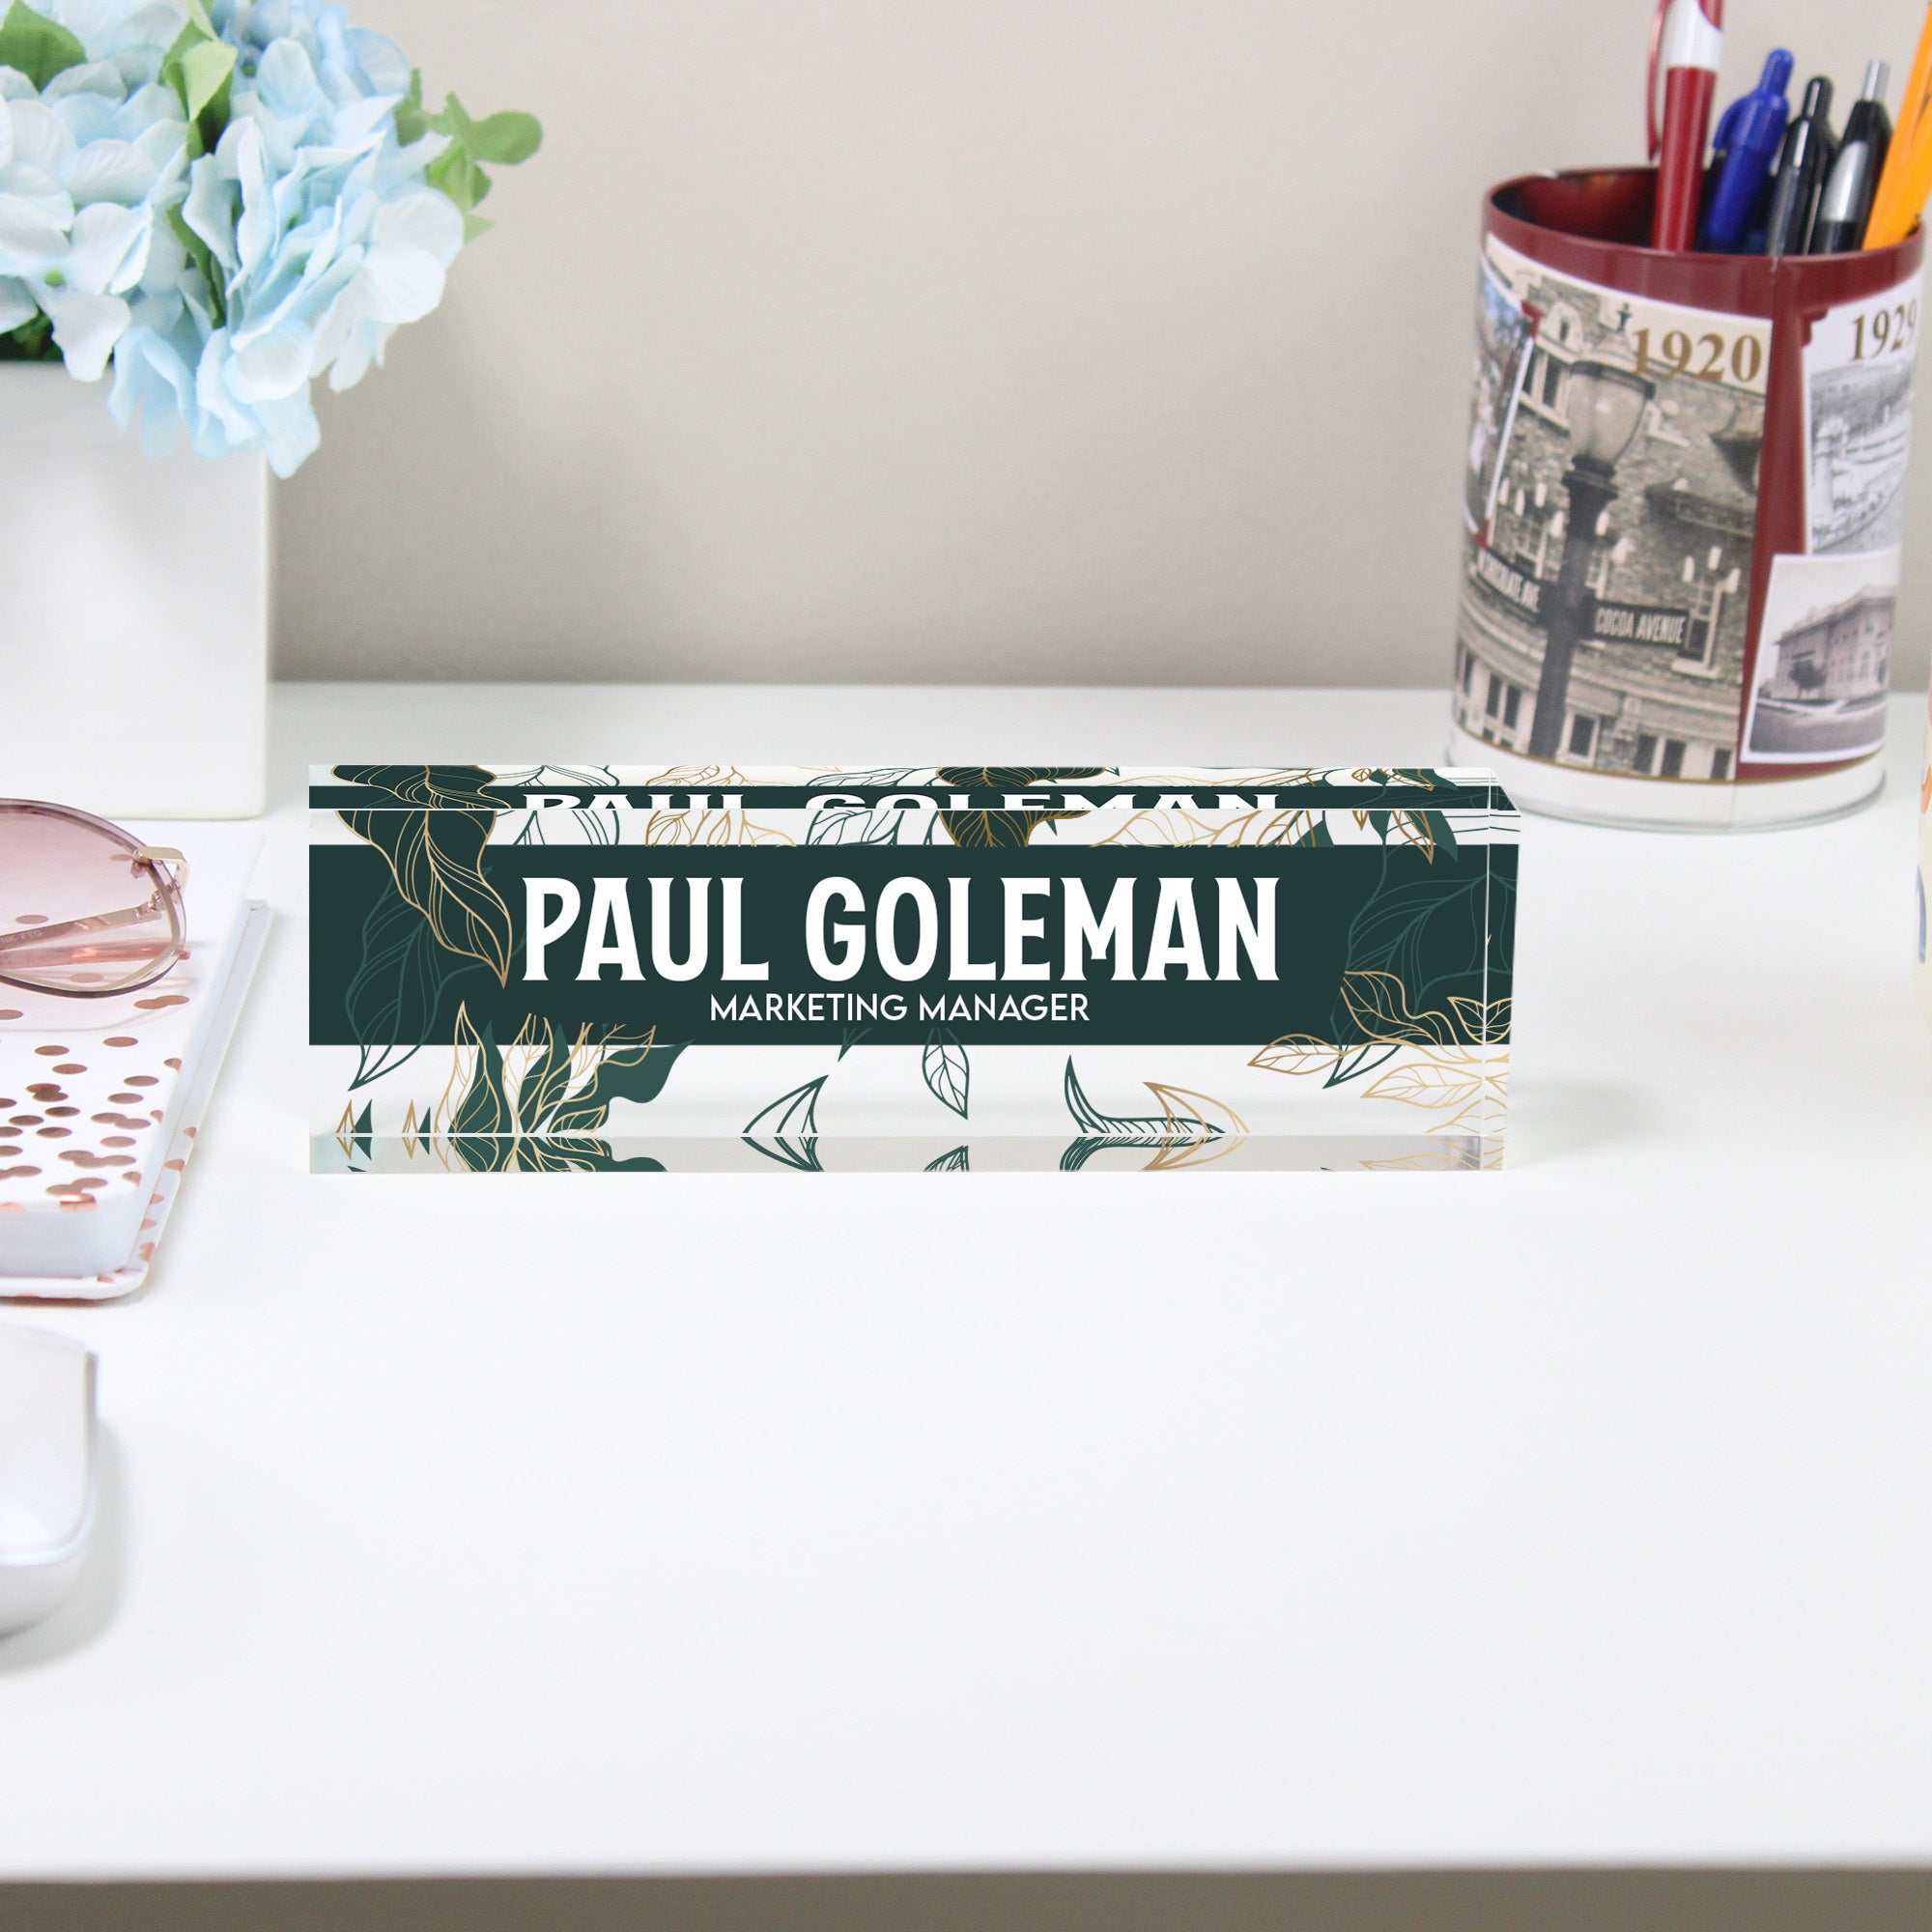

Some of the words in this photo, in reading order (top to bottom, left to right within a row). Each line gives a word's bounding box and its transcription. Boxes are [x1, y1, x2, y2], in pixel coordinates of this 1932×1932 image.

[1633, 327, 1762, 383] 1920
[1595, 608, 1634, 639] COCOA
[1635, 612, 1687, 644] AVENUE
[522, 877, 770, 981] PAUL
[805, 876, 1280, 981] GOLEMAN
[710, 993, 908, 1021] MARKETING
[919, 993, 1091, 1021] MANAGER
